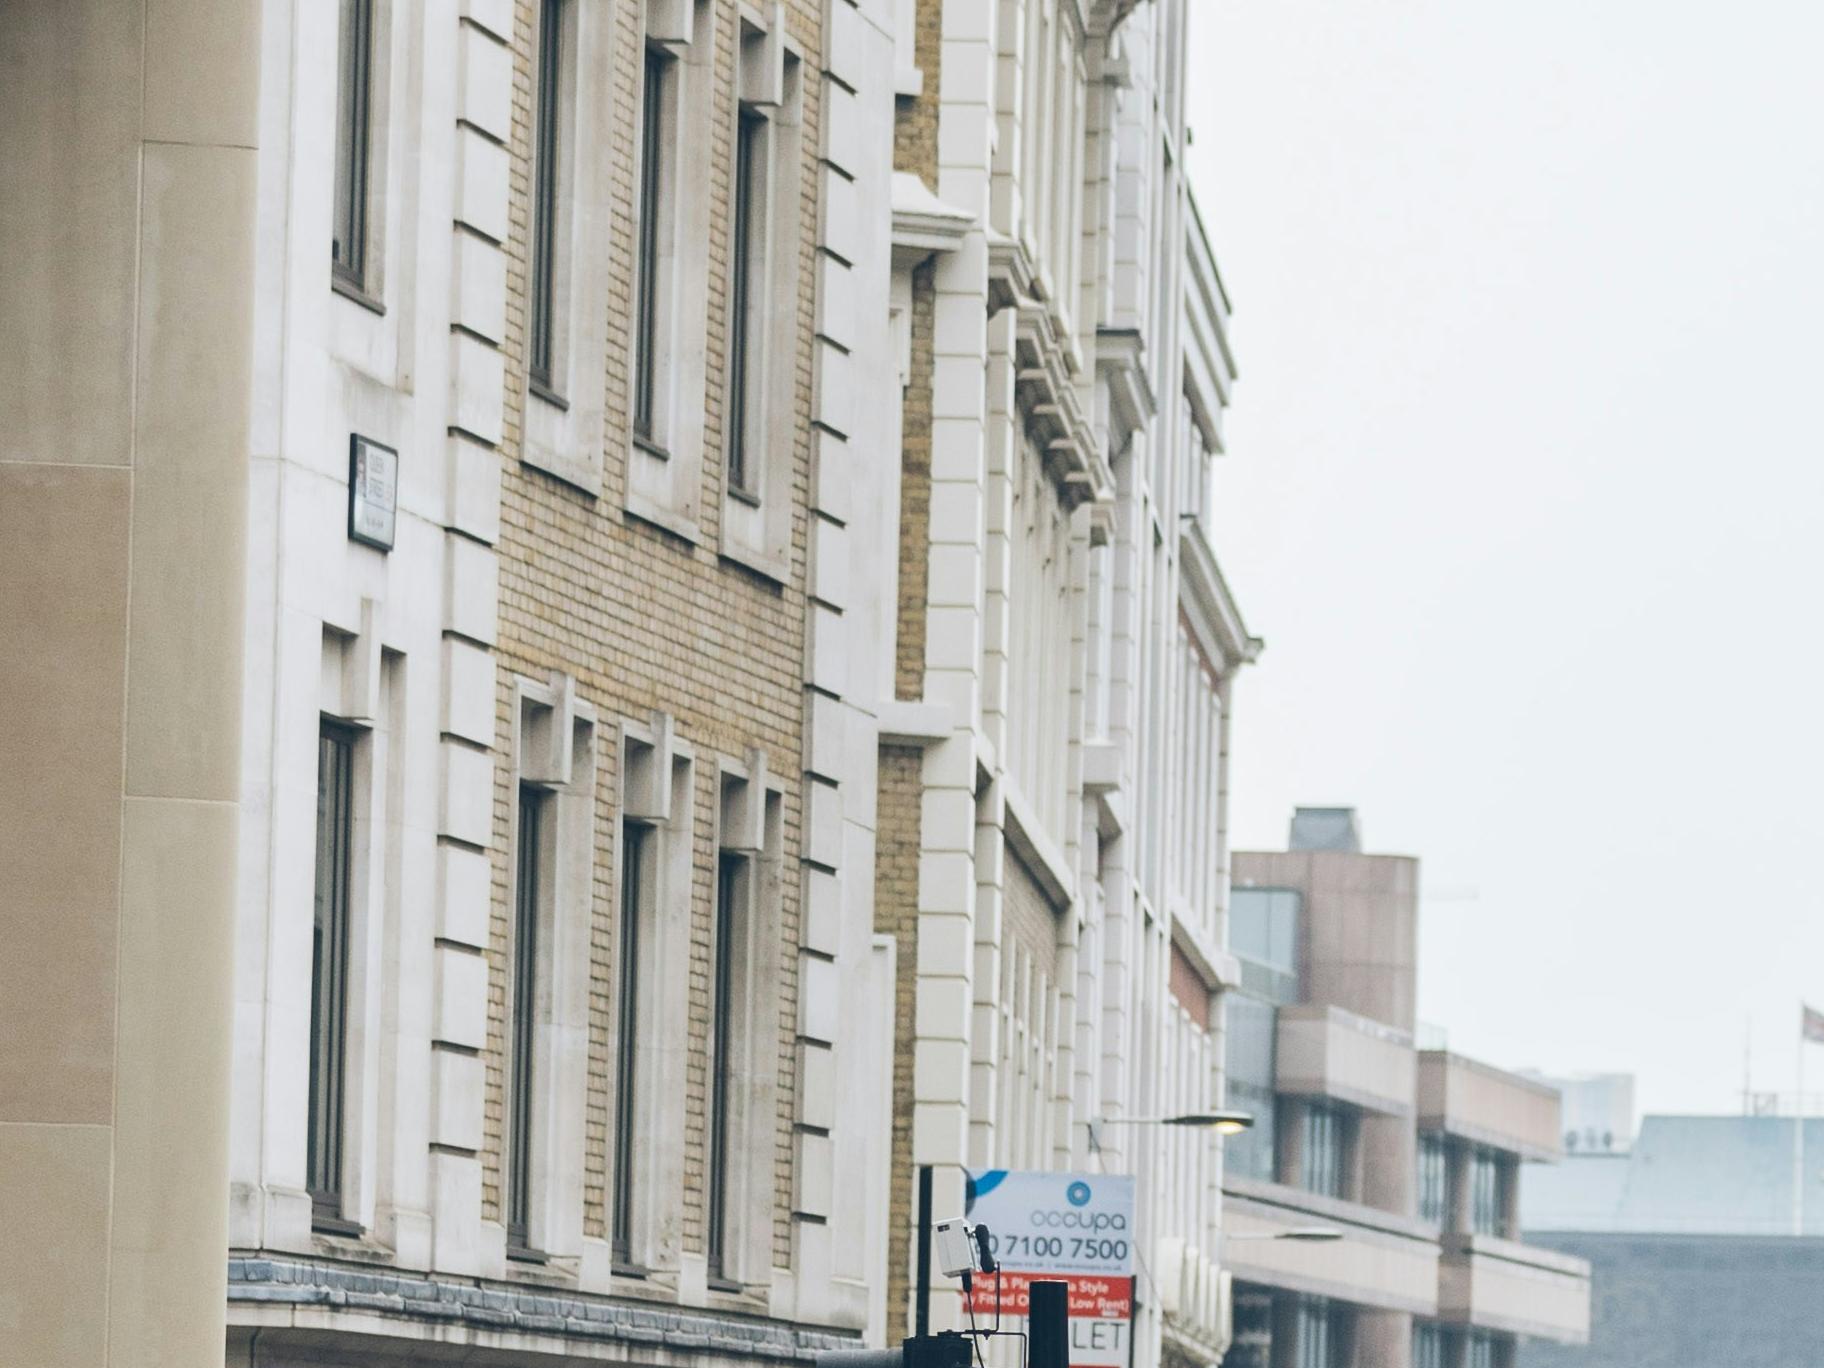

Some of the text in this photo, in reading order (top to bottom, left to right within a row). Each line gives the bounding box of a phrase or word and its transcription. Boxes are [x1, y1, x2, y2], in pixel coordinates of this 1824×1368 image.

[1030, 1210, 1126, 1234] occupa
[1005, 1235, 1063, 1257] 7100
[1070, 1238, 1128, 1260] 7500
[1078, 1280, 1109, 1296] Style
[1073, 1321, 1125, 1350] LET
